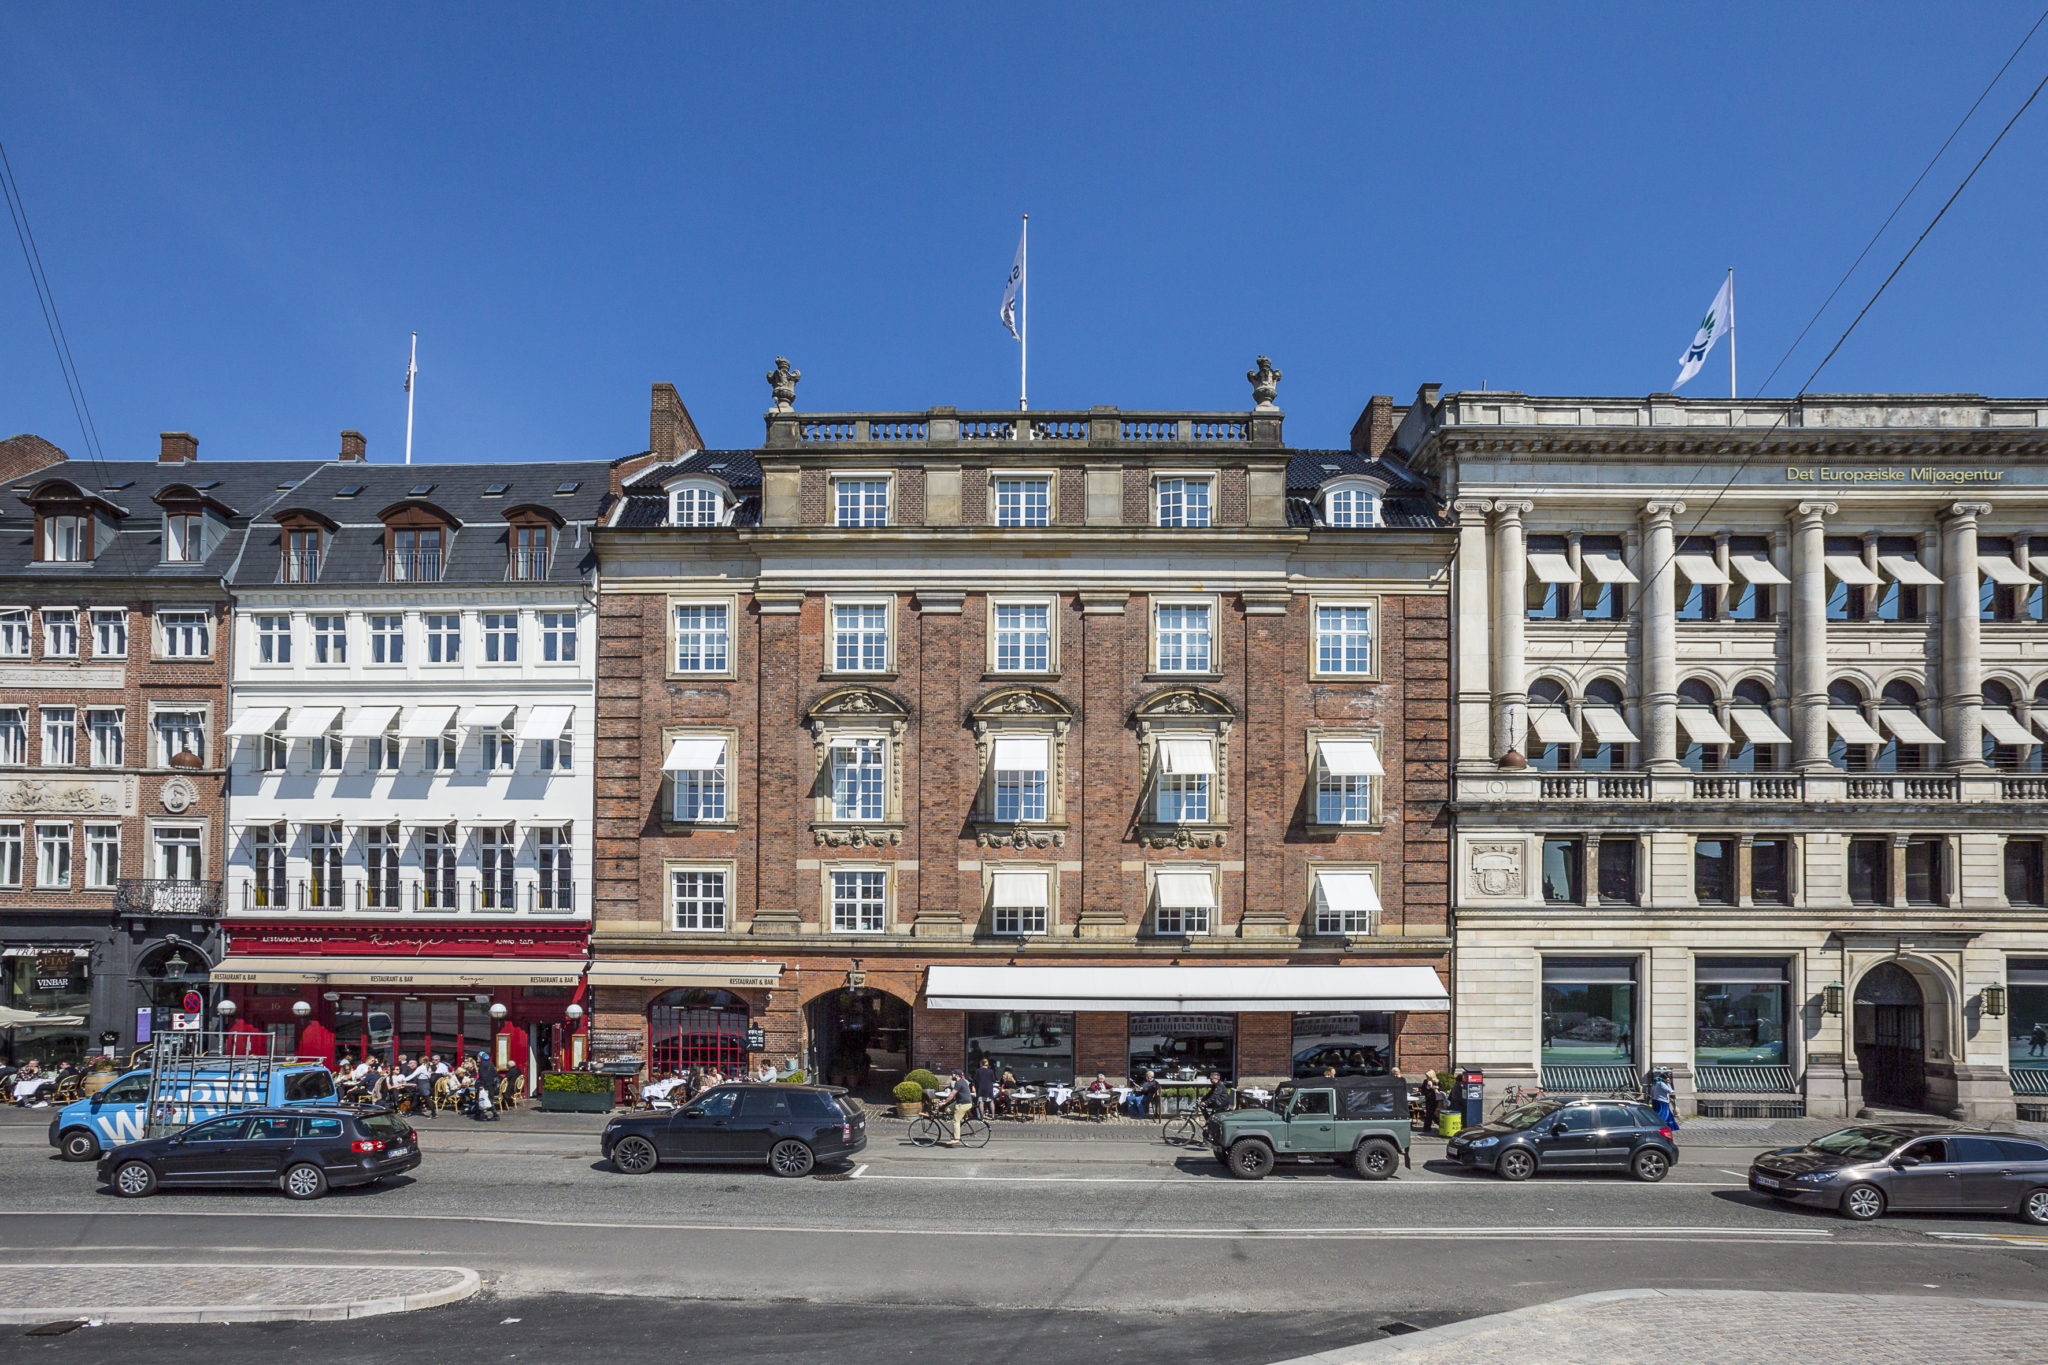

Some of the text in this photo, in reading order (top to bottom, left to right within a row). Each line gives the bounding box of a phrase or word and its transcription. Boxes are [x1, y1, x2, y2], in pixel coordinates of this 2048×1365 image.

[1786, 467, 2004, 484] Det Europæiske Miljøagentur
[370, 933, 444, 955] Ravage
[44, 957, 70, 966] FIAT
[271, 1002, 281, 1010] 16
